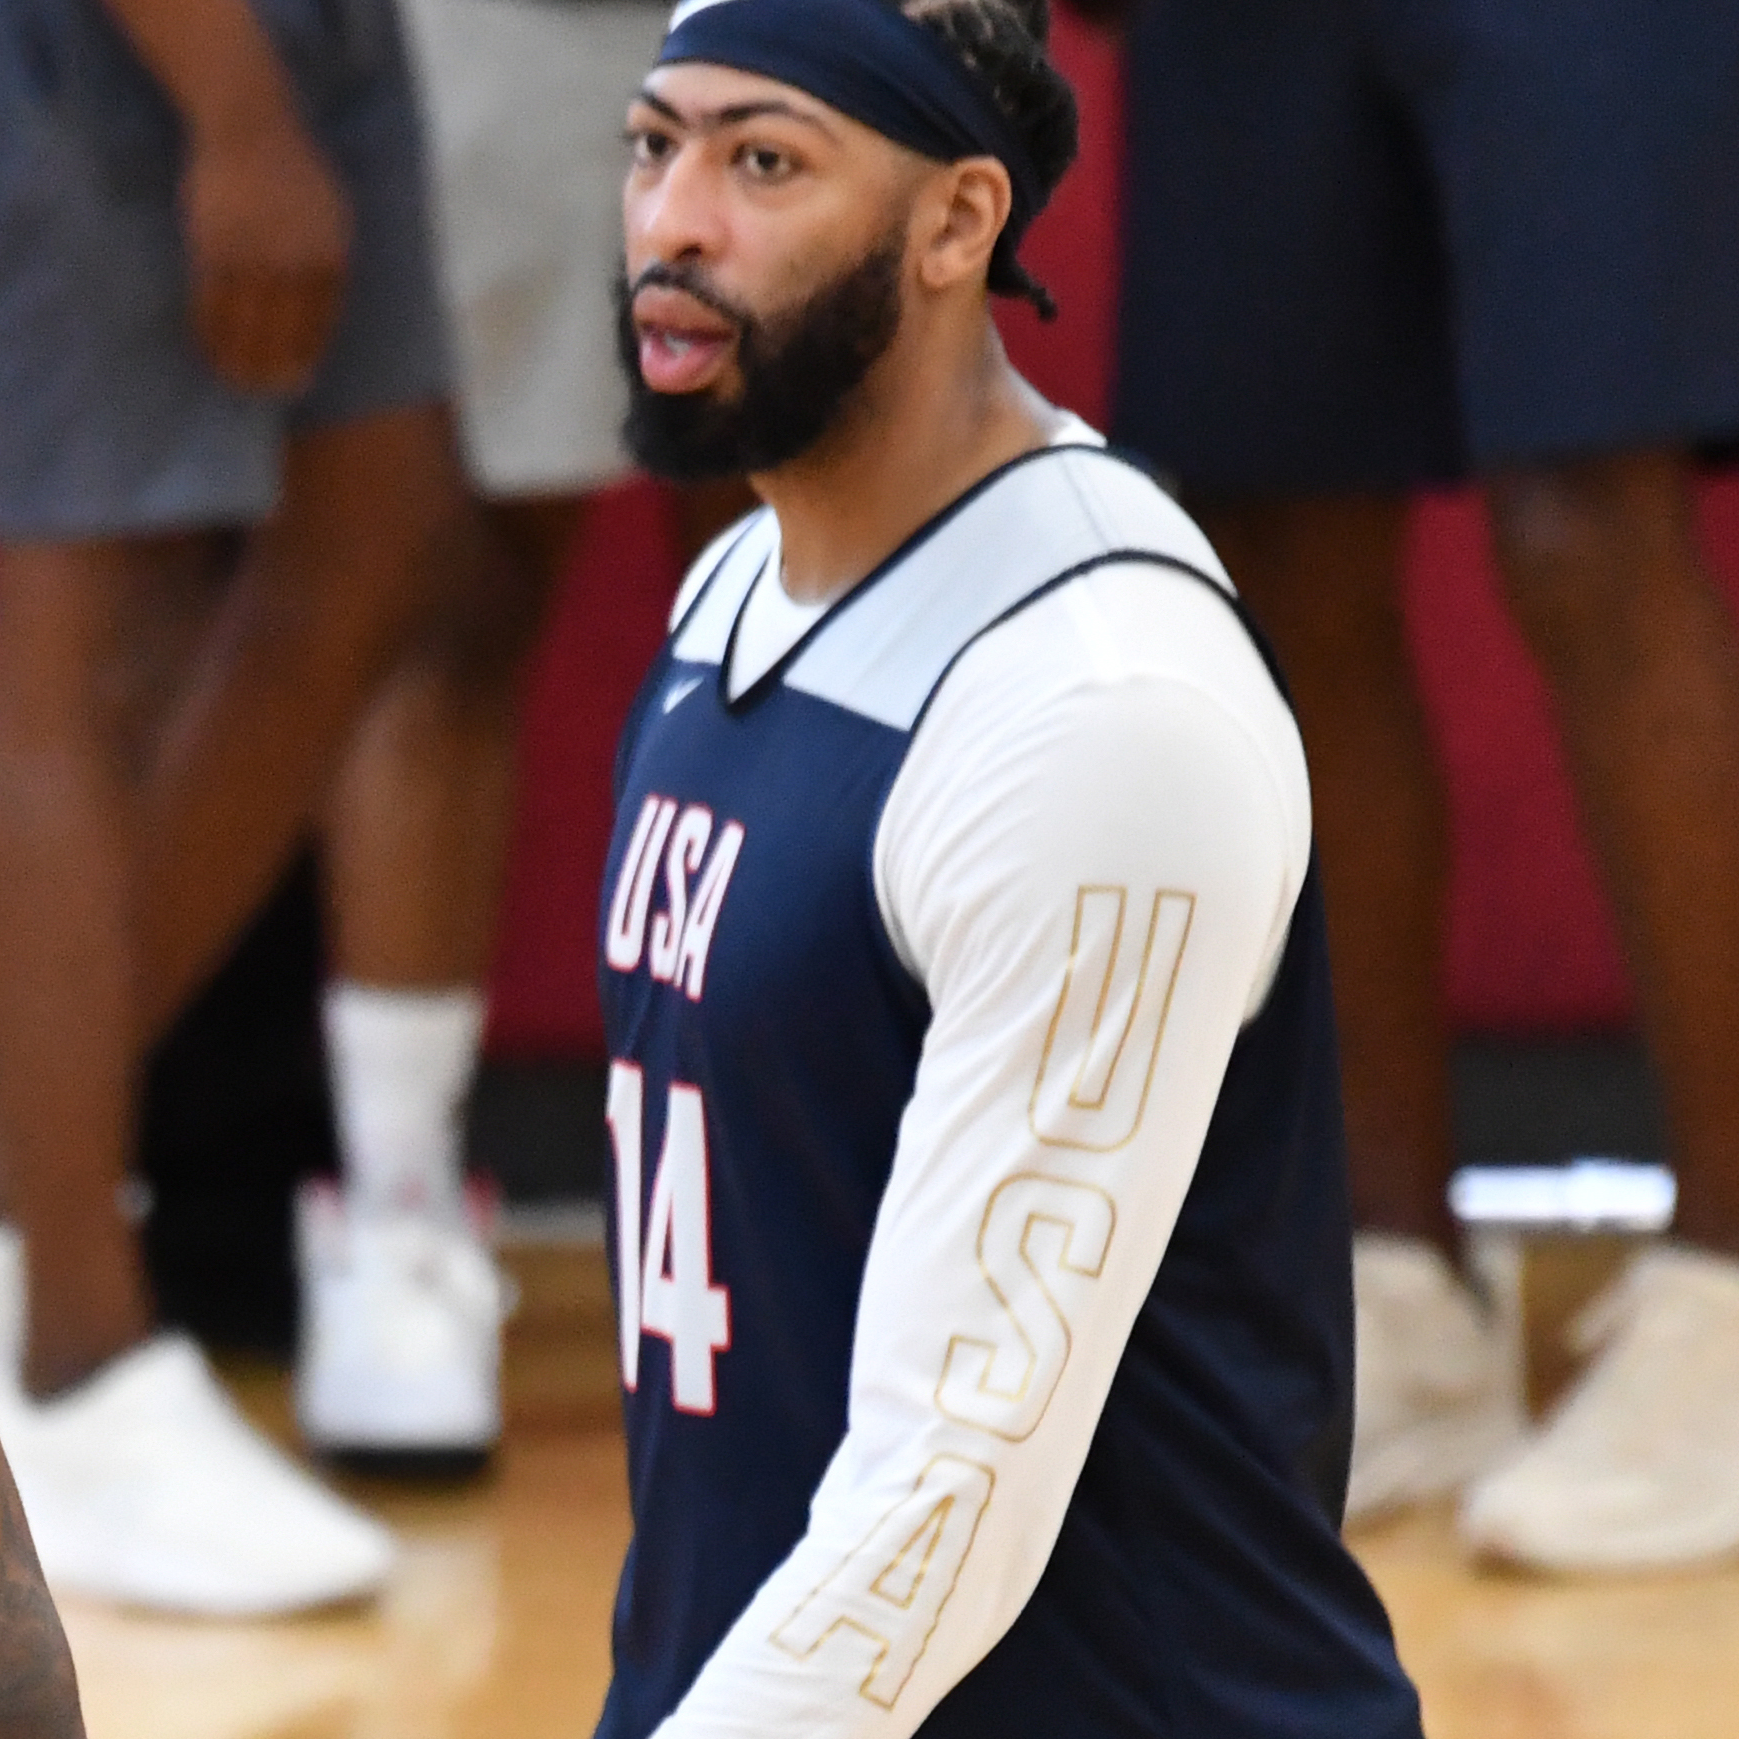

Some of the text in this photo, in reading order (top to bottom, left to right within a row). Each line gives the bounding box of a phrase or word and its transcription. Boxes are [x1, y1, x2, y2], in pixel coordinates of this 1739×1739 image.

[605, 794, 745, 1002] USA
[605, 1060, 730, 1415] 14
[767, 886, 1197, 1713] USA
